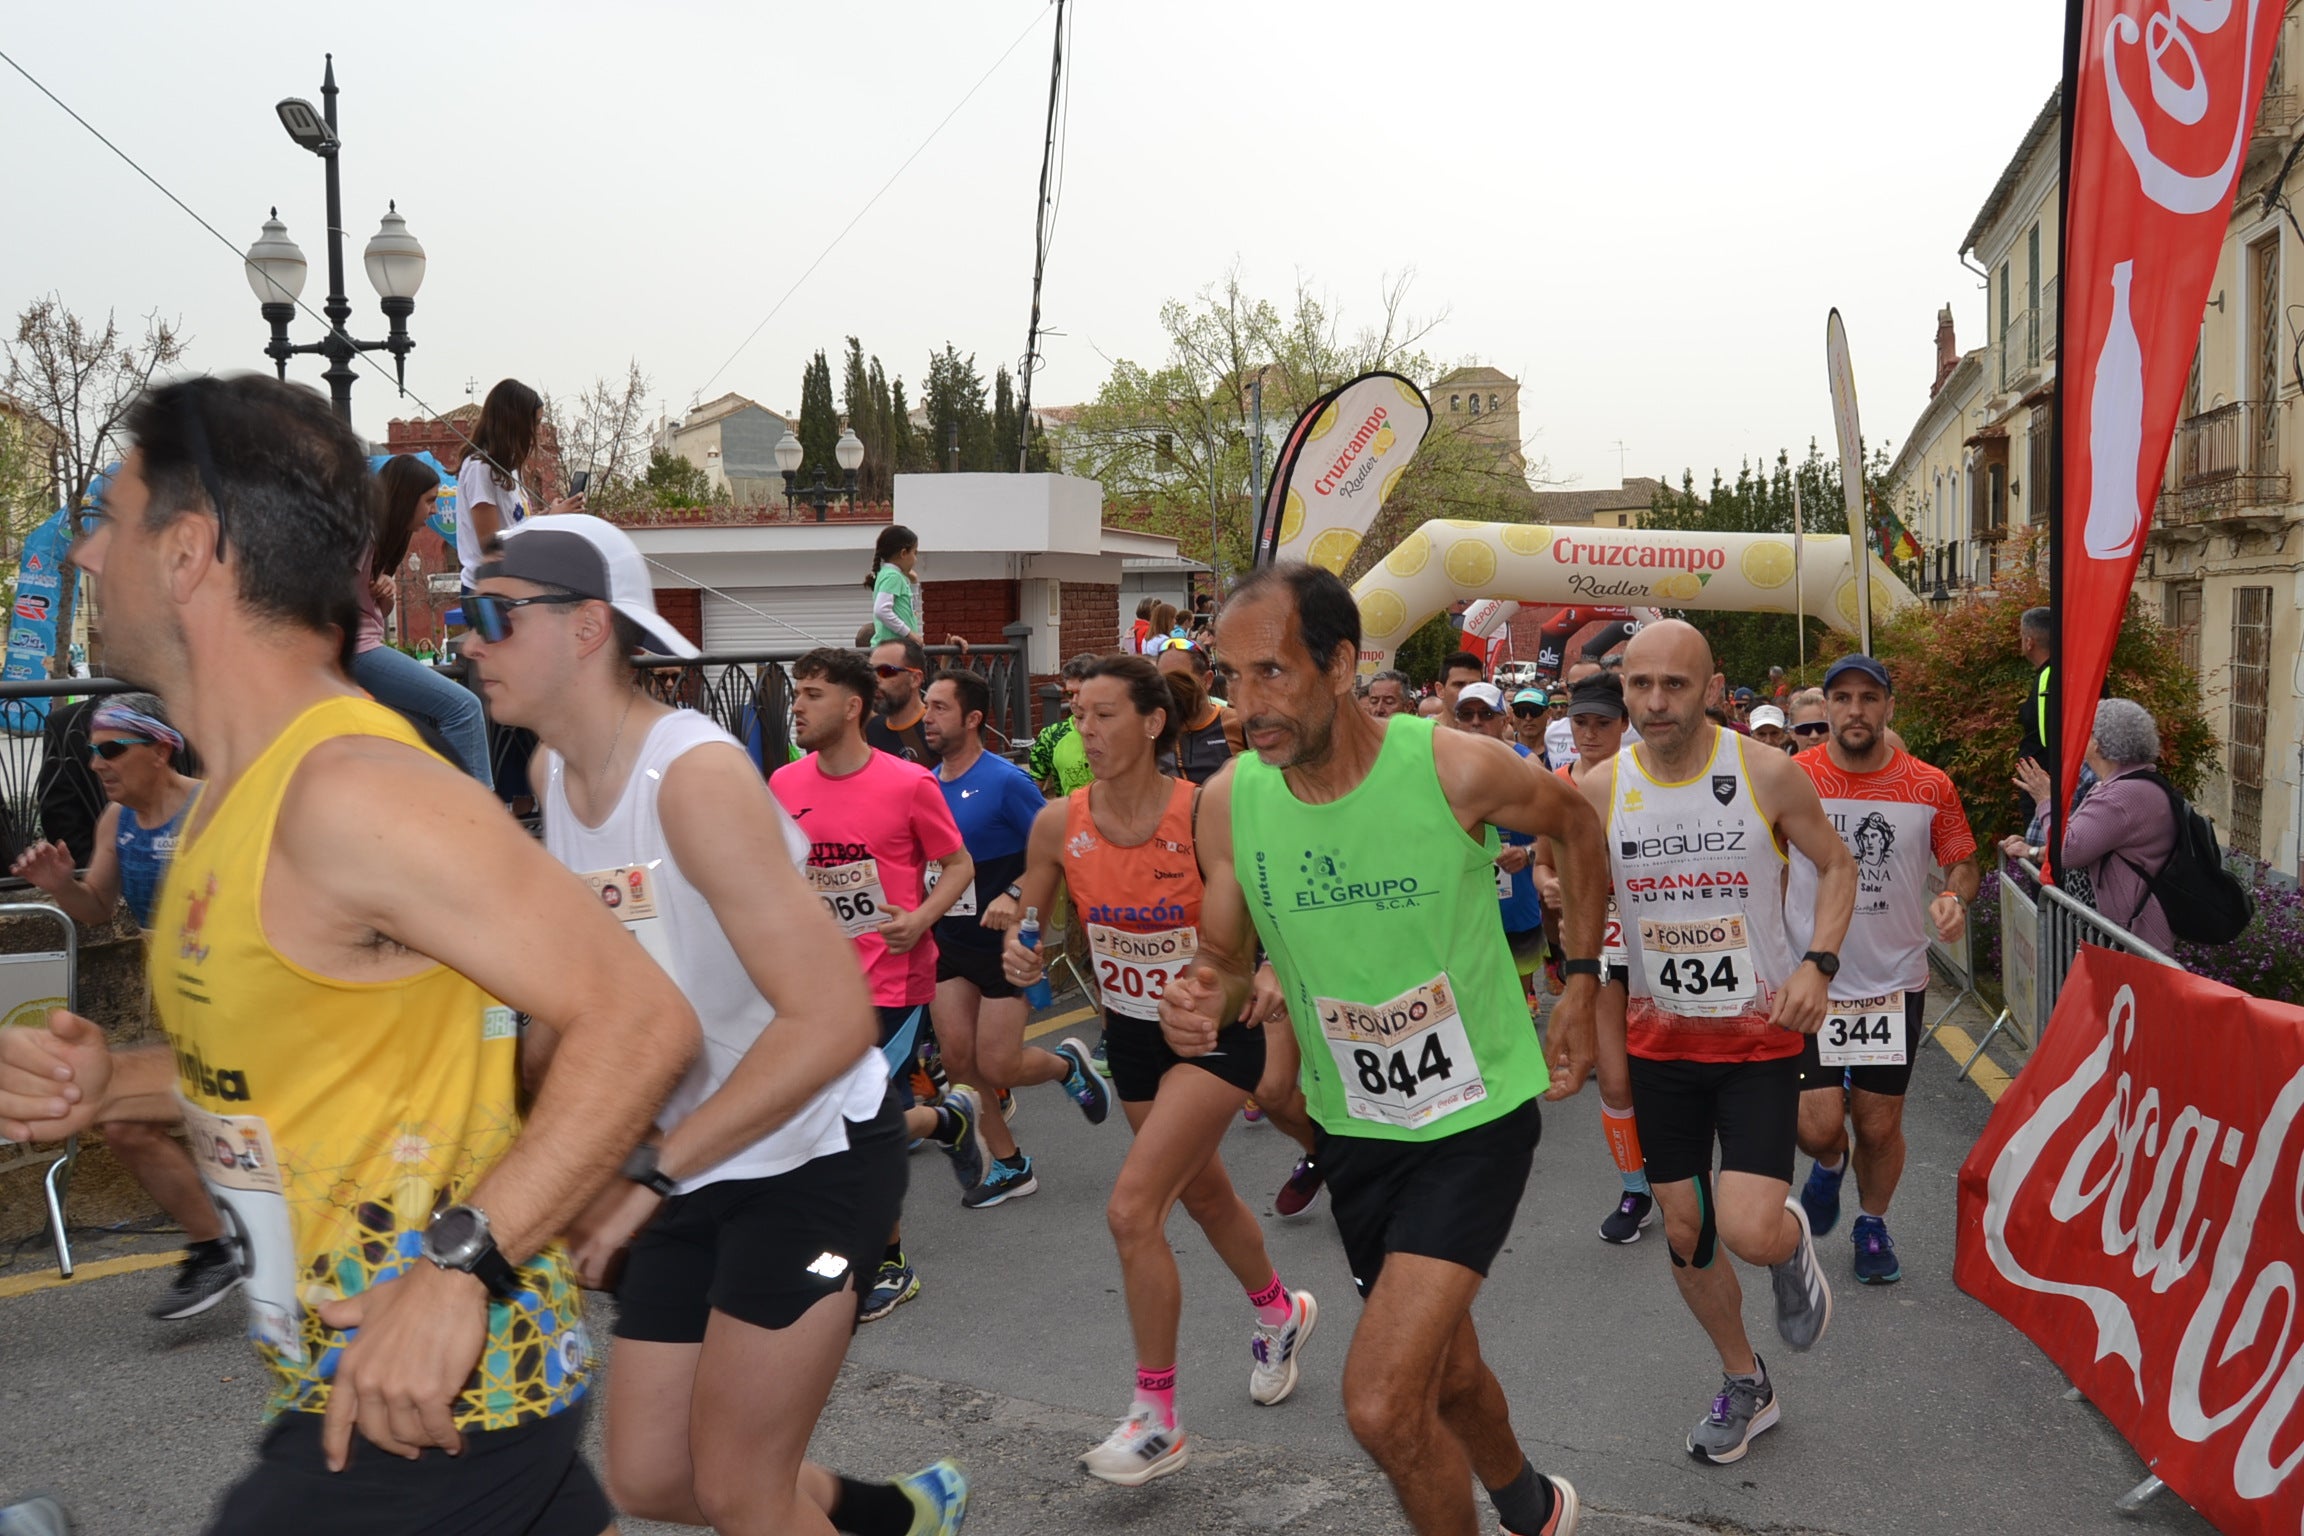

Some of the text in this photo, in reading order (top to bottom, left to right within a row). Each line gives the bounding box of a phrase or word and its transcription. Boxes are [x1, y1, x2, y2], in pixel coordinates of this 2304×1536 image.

[1314, 404, 1388, 496] Cruzcampo
[1339, 456, 1379, 498] Radler
[1553, 536, 1726, 573] Cruzcampo
[1568, 573, 1649, 598] Radler
[810, 842, 867, 859] UTBOL
[1154, 837, 1192, 856] TRACK
[817, 870, 862, 886] FONDO
[1626, 870, 1749, 892] GRANADA
[1861, 882, 1883, 893] Salar
[1296, 877, 1418, 908] EL GRUPO
[1376, 898, 1421, 911] S.C.A.
[1632, 887, 1749, 904] RUNNERS
[1088, 897, 1185, 923] atracón
[1111, 937, 1176, 957] FONDO
[1602, 921, 1628, 948] 2
[1659, 927, 1726, 946] FONDO
[1659, 955, 1739, 995] 434
[1347, 1001, 1428, 1036] FONDO
[1828, 1015, 1892, 1047] 344
[1353, 1032, 1453, 1099] 844
